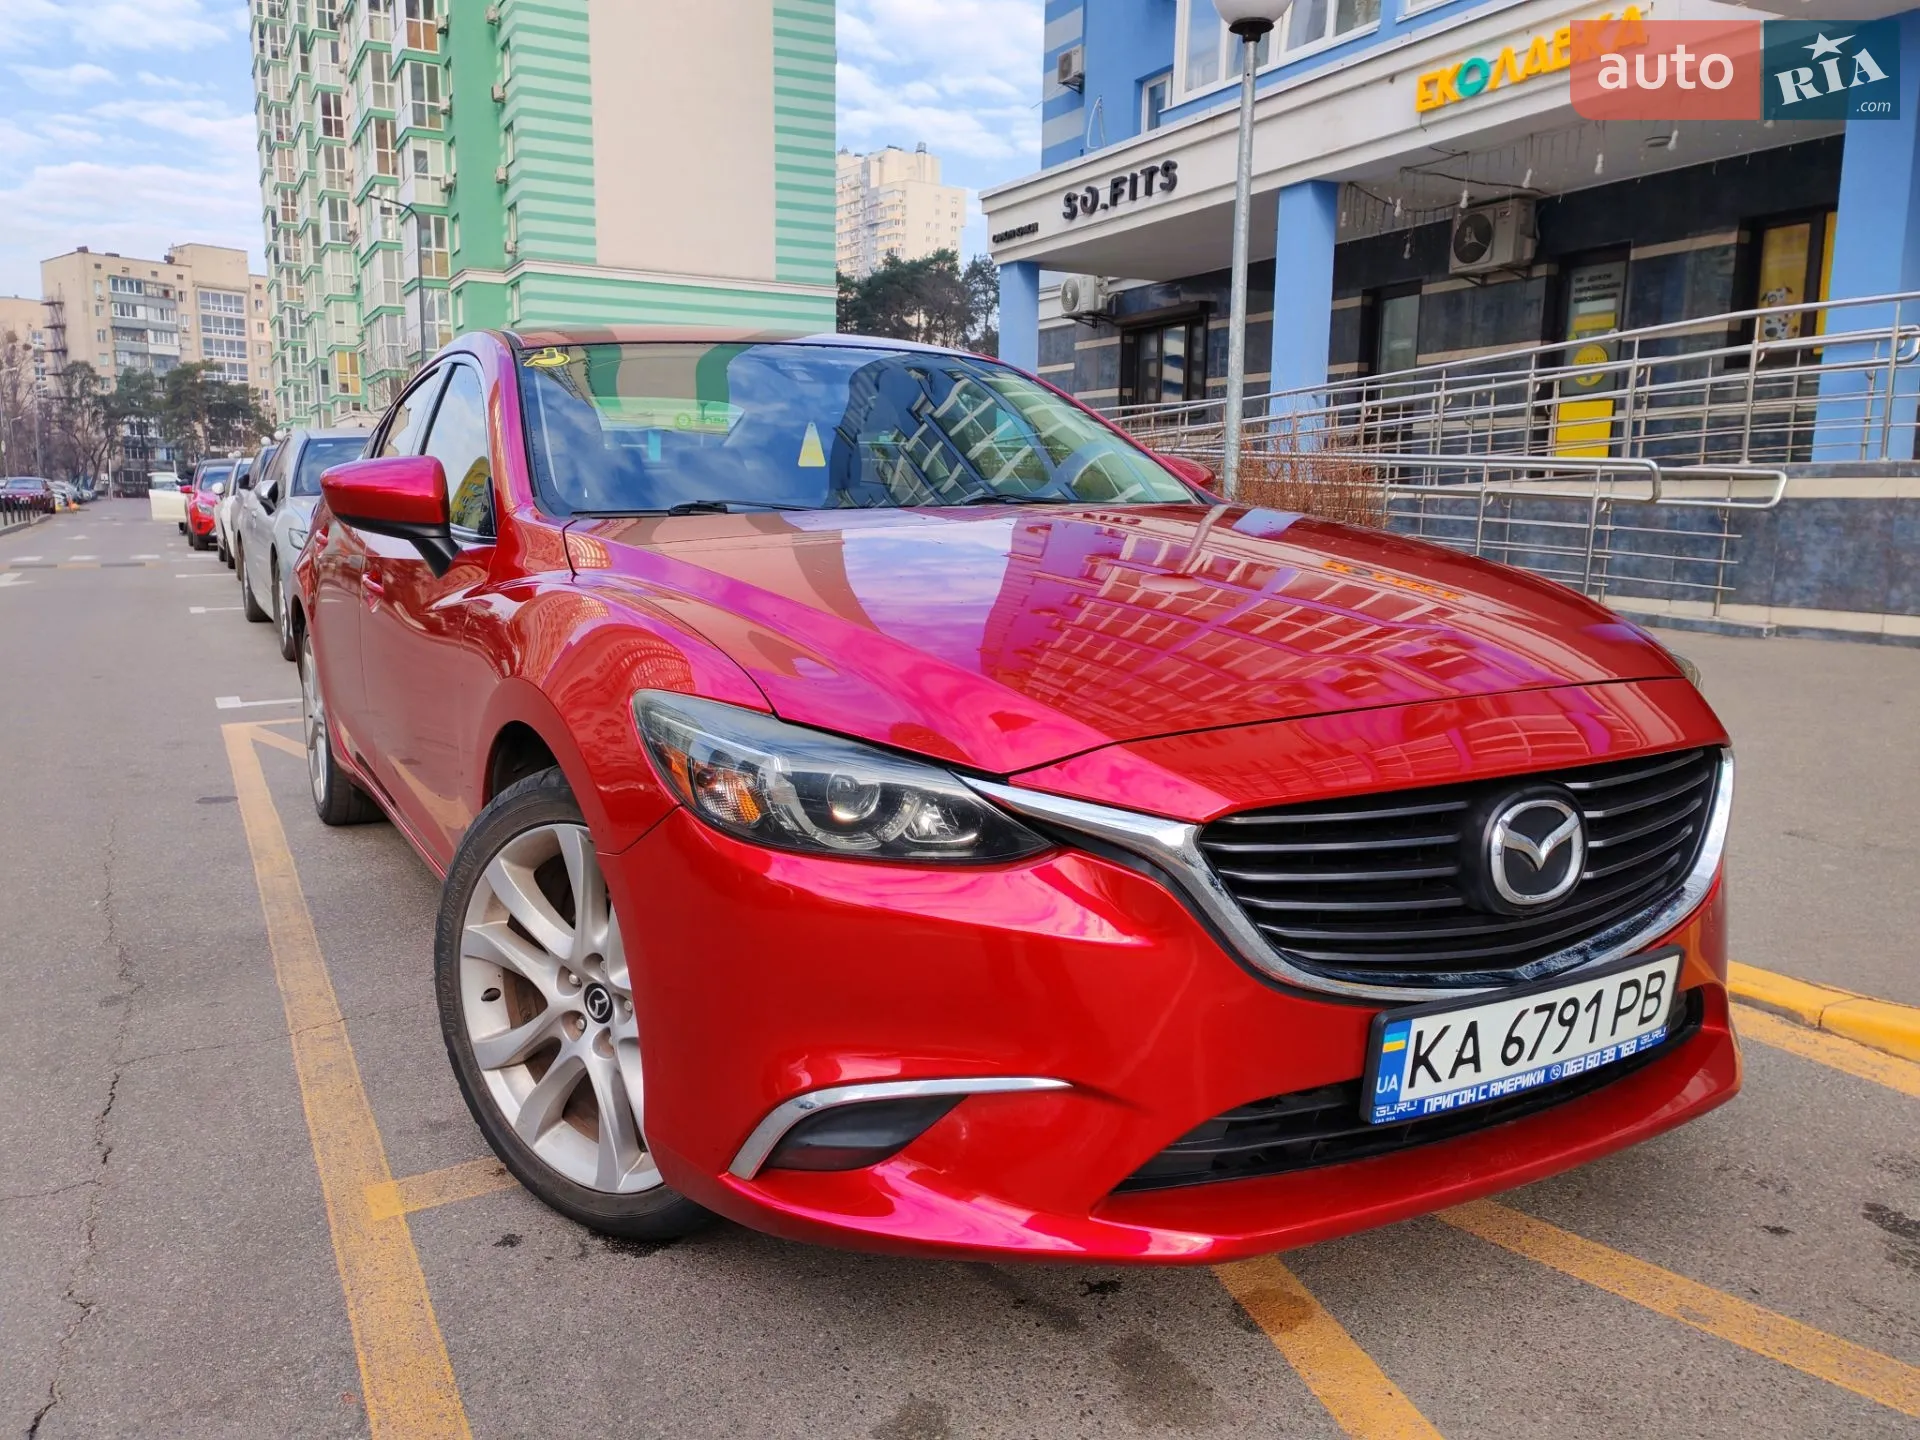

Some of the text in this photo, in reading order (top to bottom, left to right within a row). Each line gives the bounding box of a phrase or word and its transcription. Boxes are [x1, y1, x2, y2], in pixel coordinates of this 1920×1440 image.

[1415, 5, 1648, 113] ЕКОЛАВКА
[1062, 160, 1178, 220] SO.FITS
[1408, 970, 1667, 1089] KA 6791 PB
[1375, 1100, 1418, 1118] GURU
[1376, 1074, 1398, 1094] UA
[1423, 1087, 1476, 1114] ПРИГОН
[1489, 1069, 1545, 1098] АМЕРИКИ
[1562, 1059, 1585, 1078] 063
[1585, 1053, 1600, 1071] 60
[1600, 1047, 1616, 1065] 39
[1618, 1039, 1638, 1059] 769
